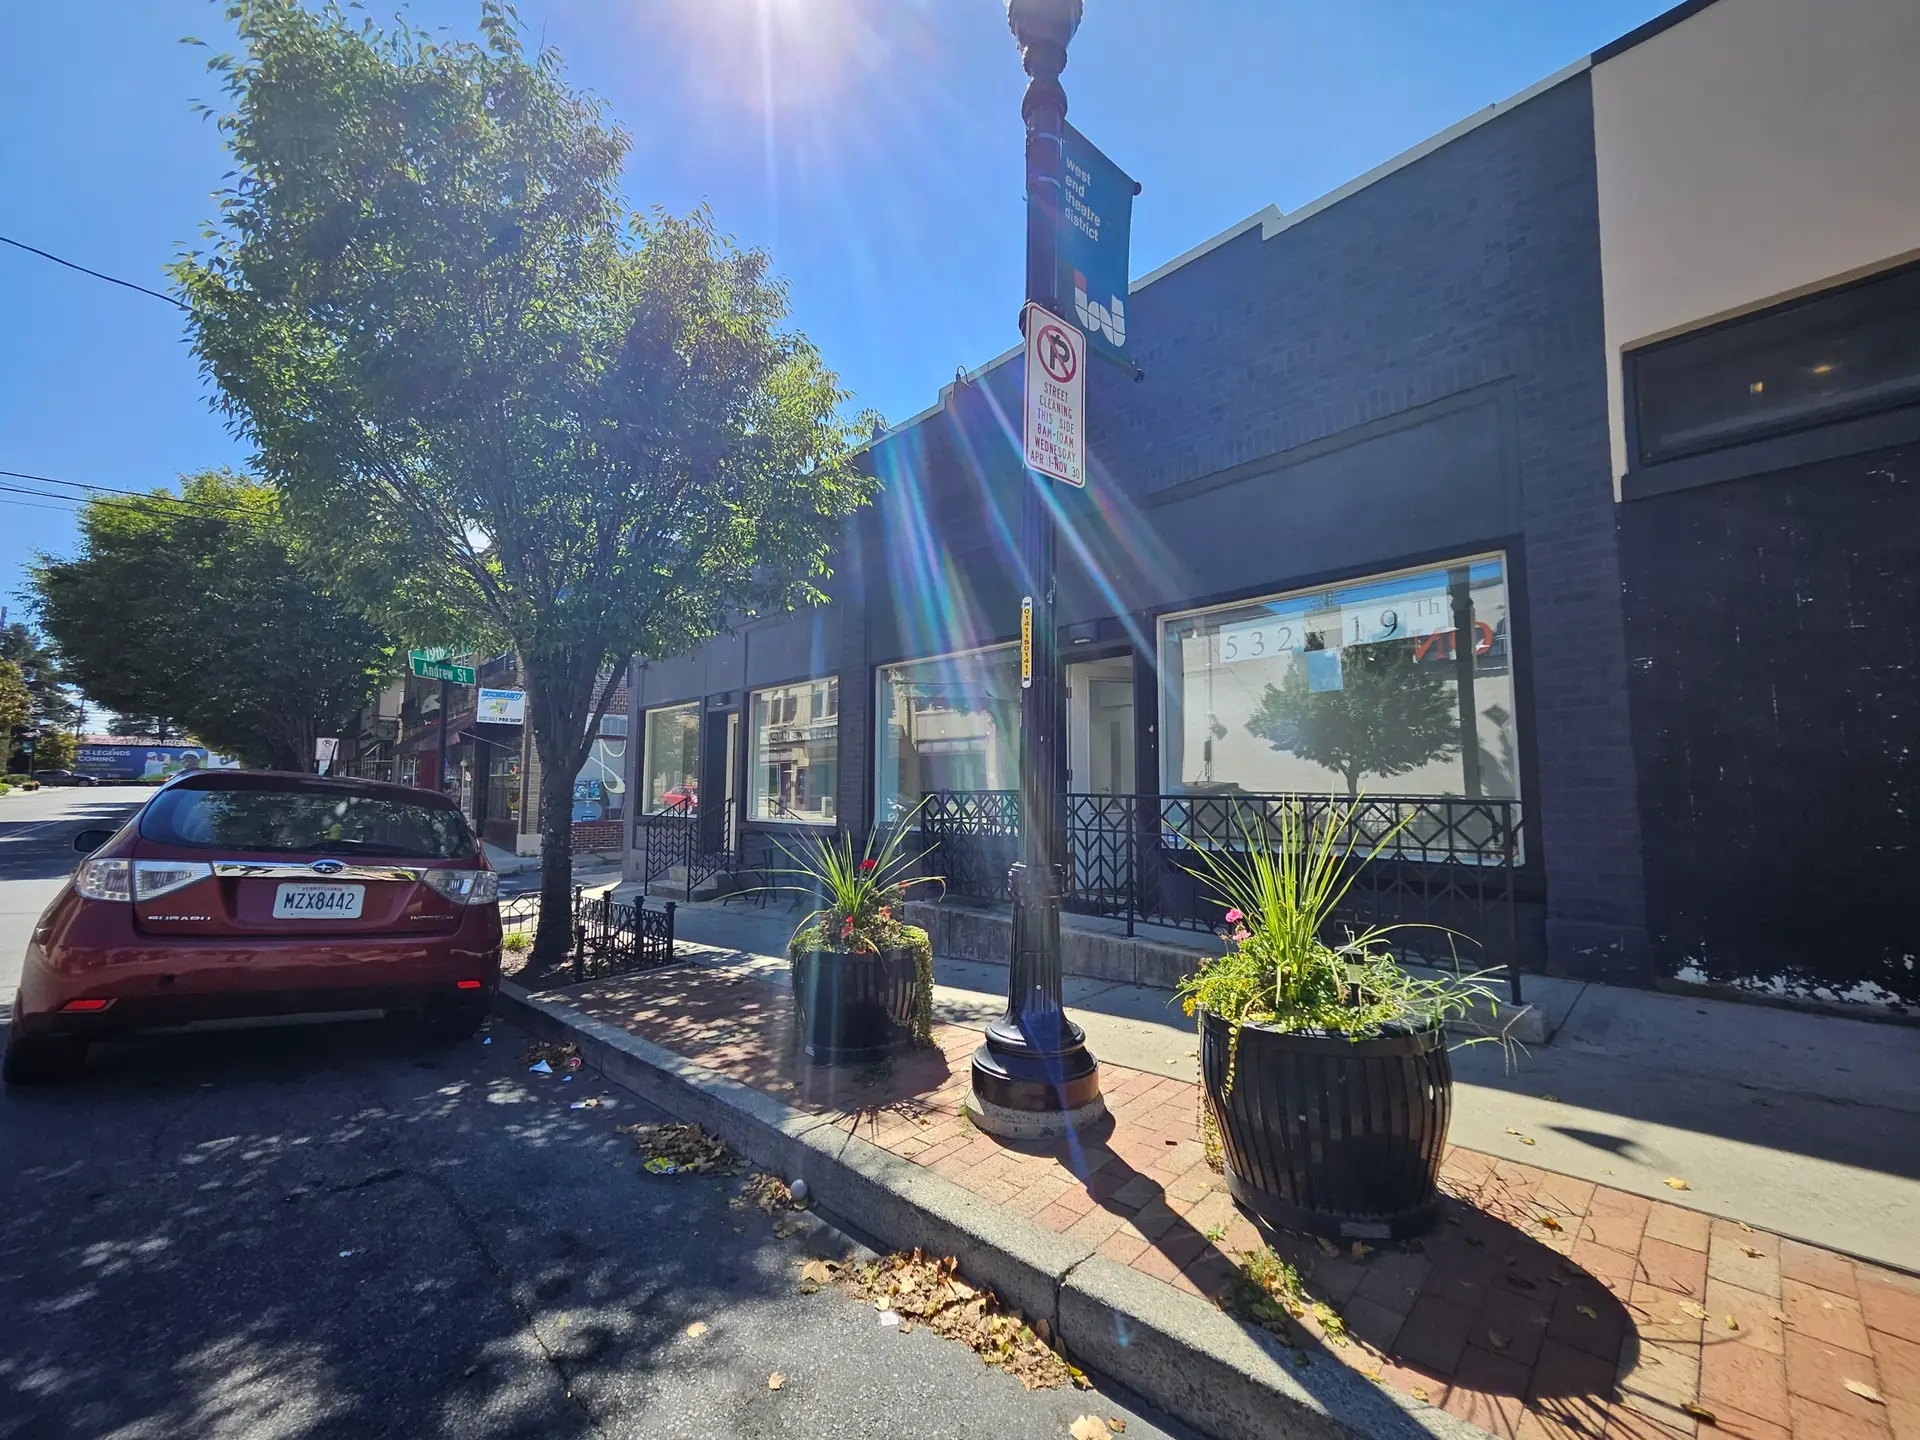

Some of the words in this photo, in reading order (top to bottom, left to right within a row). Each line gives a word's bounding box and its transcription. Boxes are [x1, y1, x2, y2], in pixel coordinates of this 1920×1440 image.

[1066, 157, 1091, 186] west
[1065, 175, 1085, 198] end
[1065, 188, 1100, 226] theatre
[1065, 207, 1099, 242] district
[1044, 382, 1068, 402] STREET
[1039, 394, 1073, 419] CLEANING
[1037, 408, 1053, 424] THIS
[1059, 419, 1074, 435] SIDE
[1037, 422, 1074, 448] 8AM-10AM
[1034, 435, 1076, 464] WEDNESDAY
[1030, 450, 1044, 465] APR
[1072, 467, 1080, 480] 30
[1225, 626, 1294, 660] 532
[422, 662, 453, 681] Andrew
[457, 668, 467, 682] St
[283, 891, 355, 911] MZX8442
